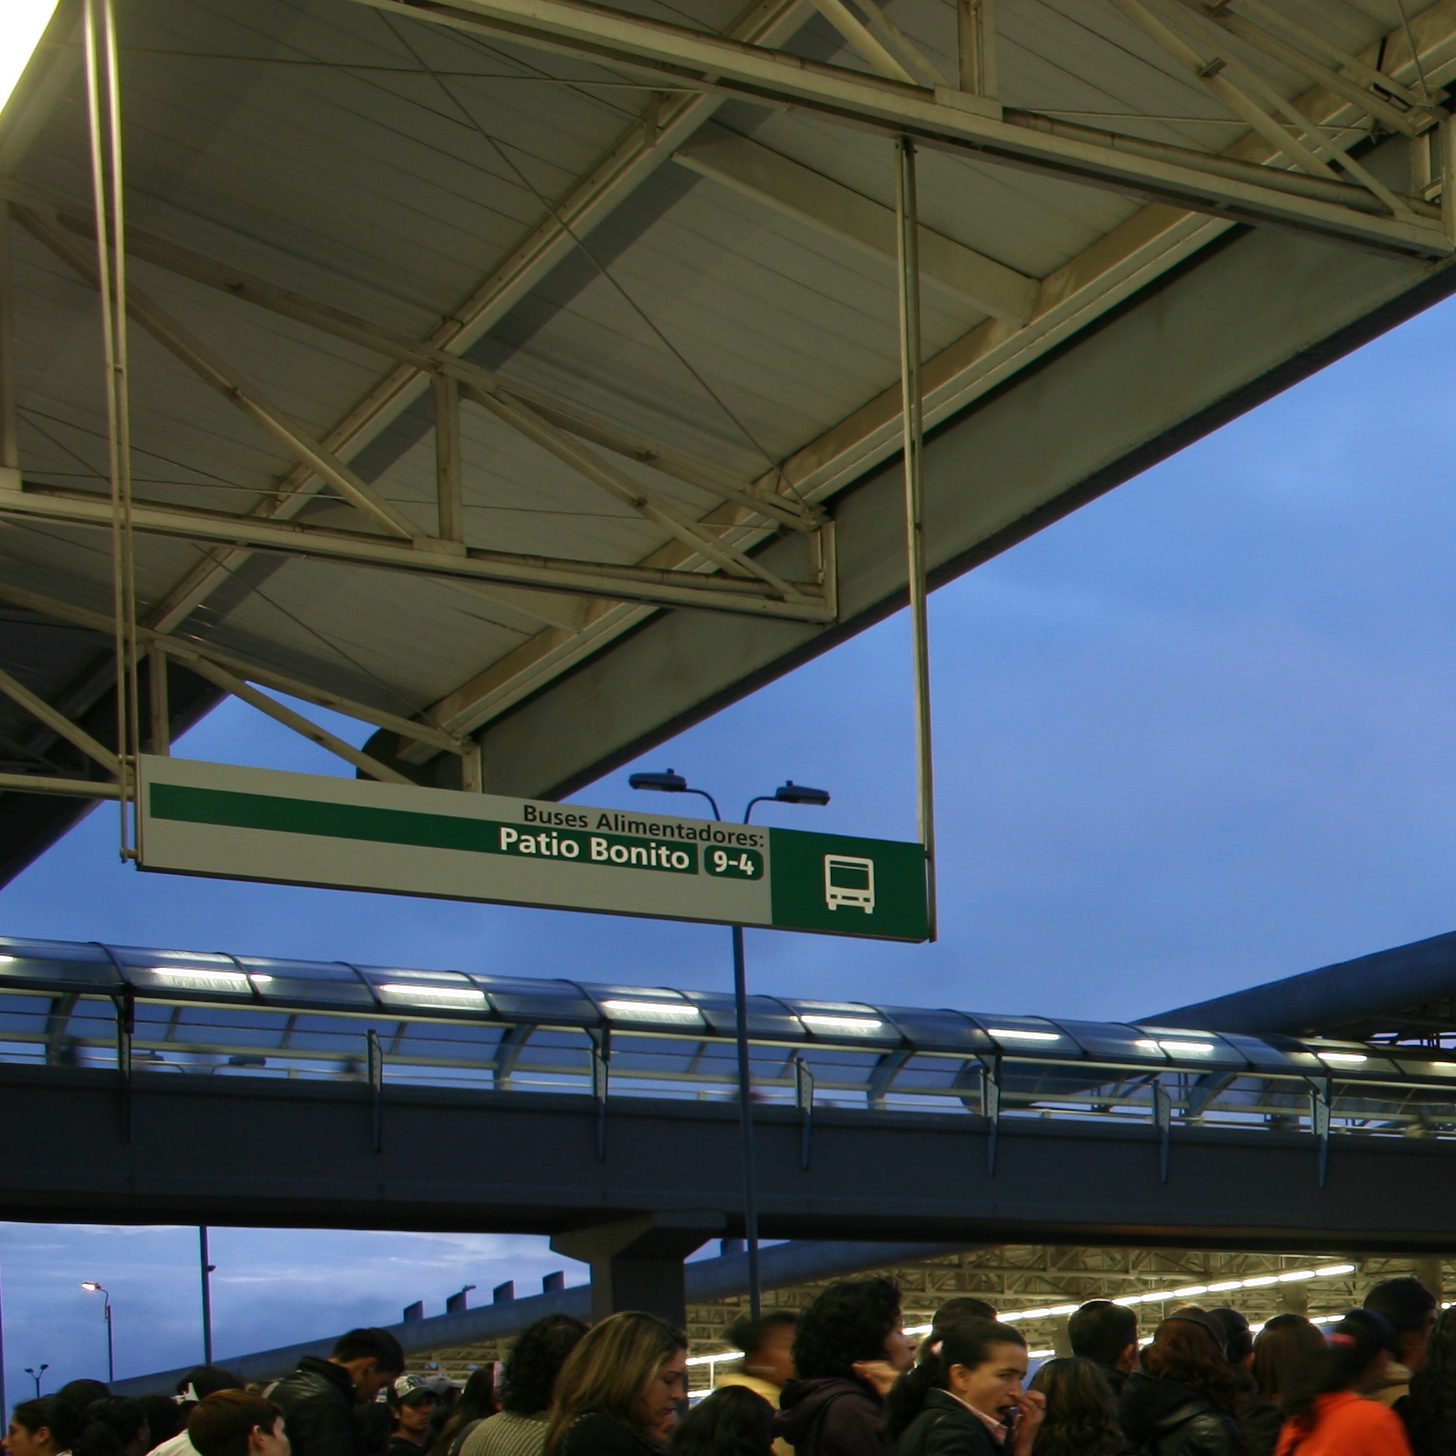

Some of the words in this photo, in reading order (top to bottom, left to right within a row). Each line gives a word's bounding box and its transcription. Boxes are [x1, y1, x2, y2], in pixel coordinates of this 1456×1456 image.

[523, 804, 589, 829] Buses
[596, 812, 765, 848] Alimentadores:
[499, 826, 580, 859] Patio
[589, 836, 690, 870] Bonito
[712, 851, 755, 876] 9-4
